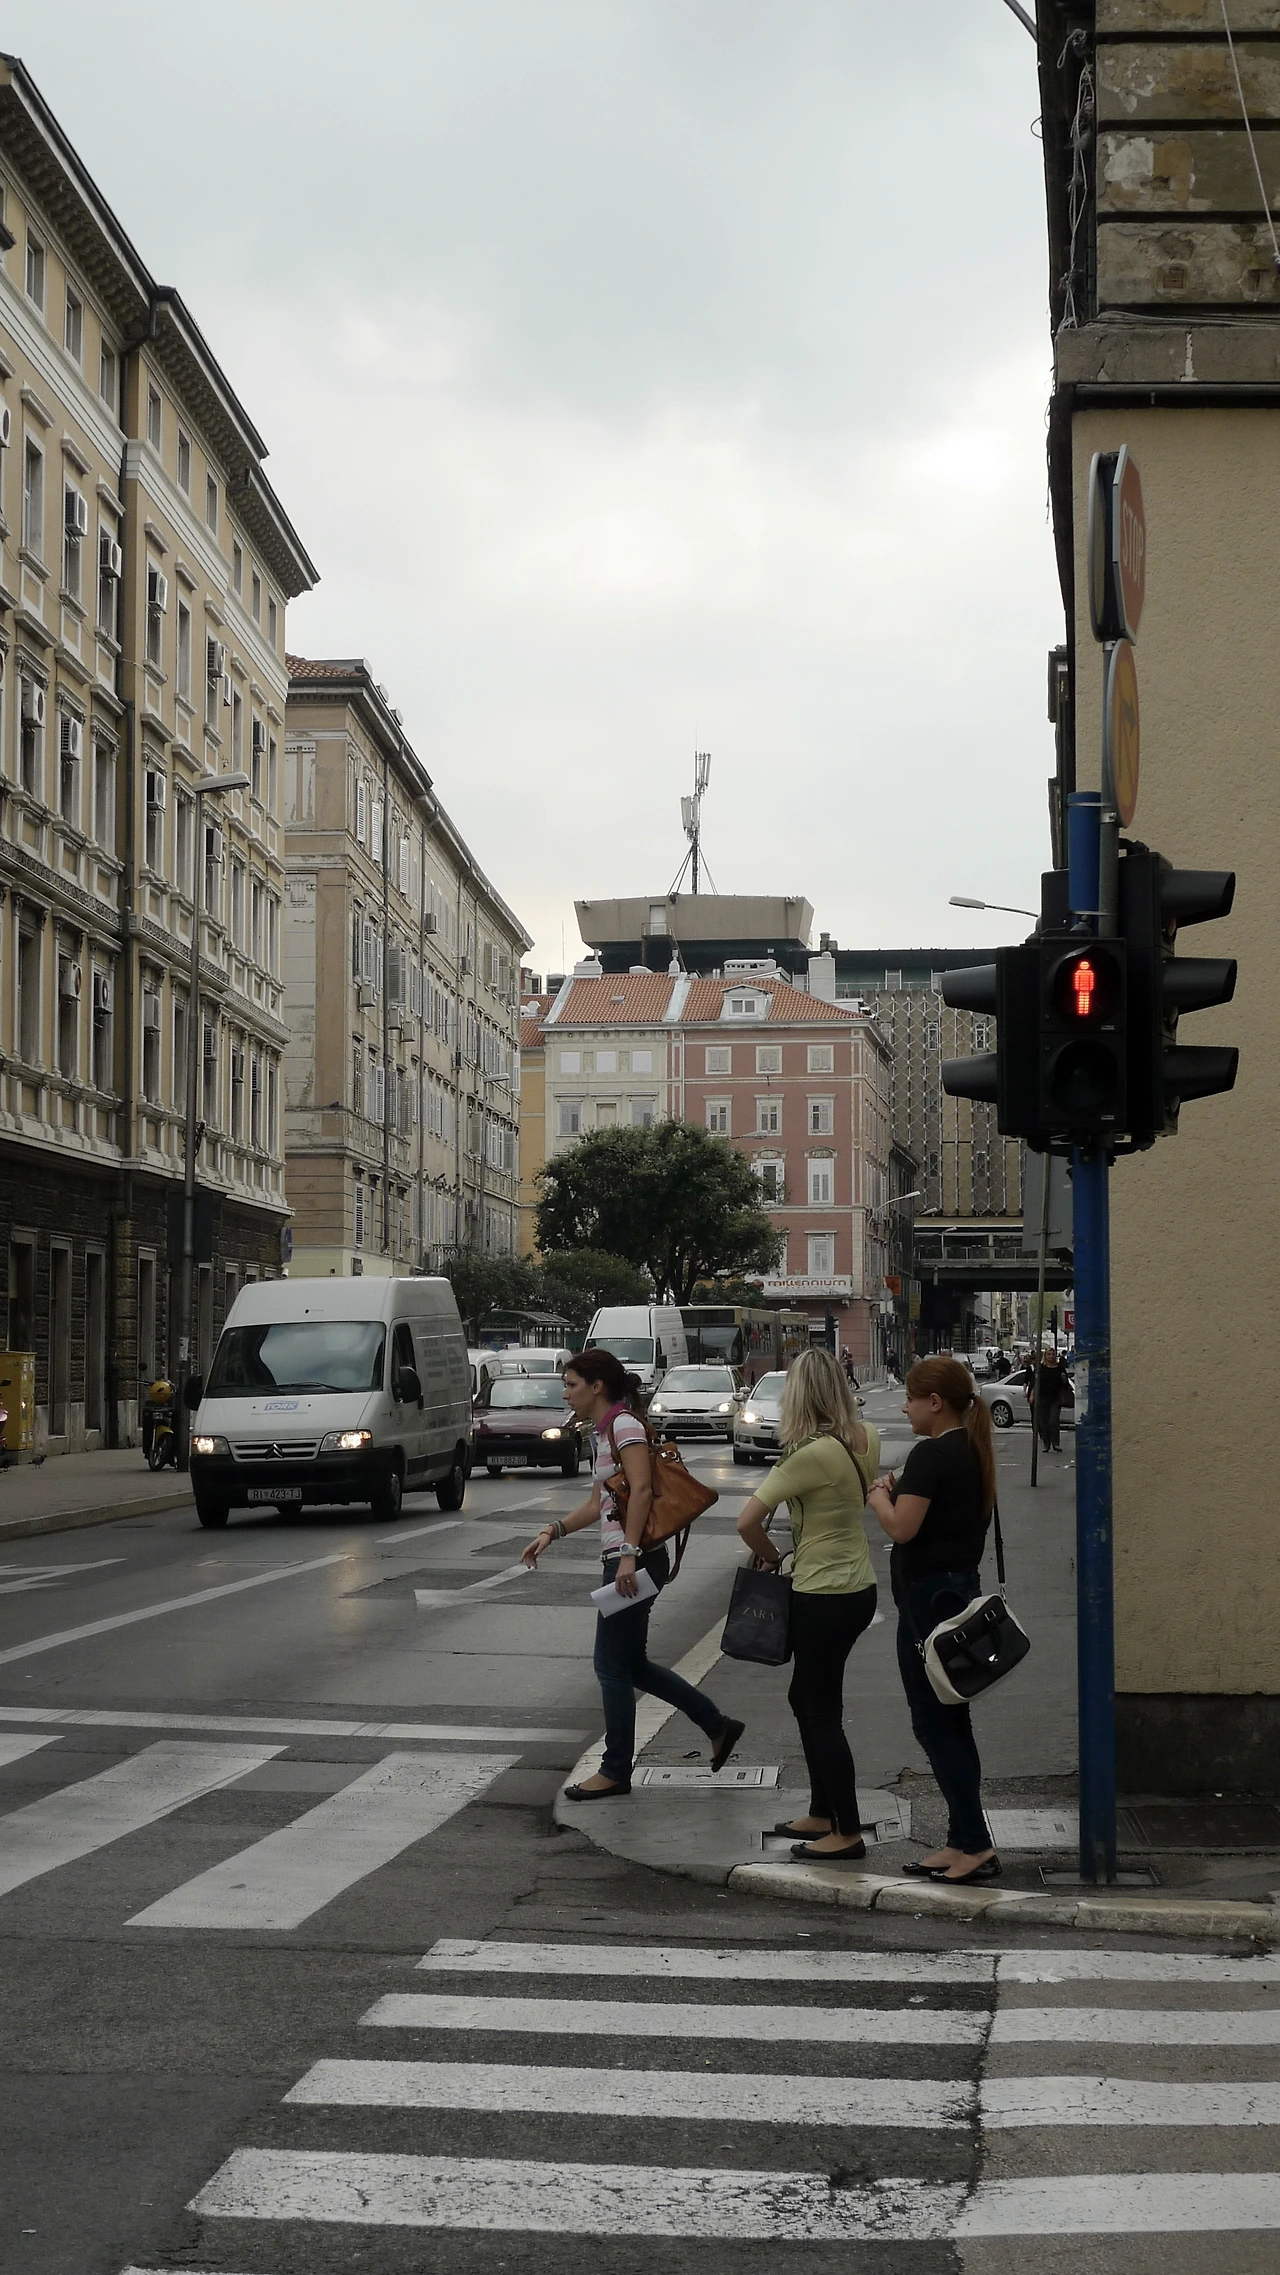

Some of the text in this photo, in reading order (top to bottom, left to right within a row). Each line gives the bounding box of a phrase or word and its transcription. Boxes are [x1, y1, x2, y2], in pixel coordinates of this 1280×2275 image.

[1122, 498, 1144, 589] STOP
[266, 1402, 297, 1410] TORK
[253, 1490, 263, 1499] RI
[742, 1606, 776, 1621] ZARA
